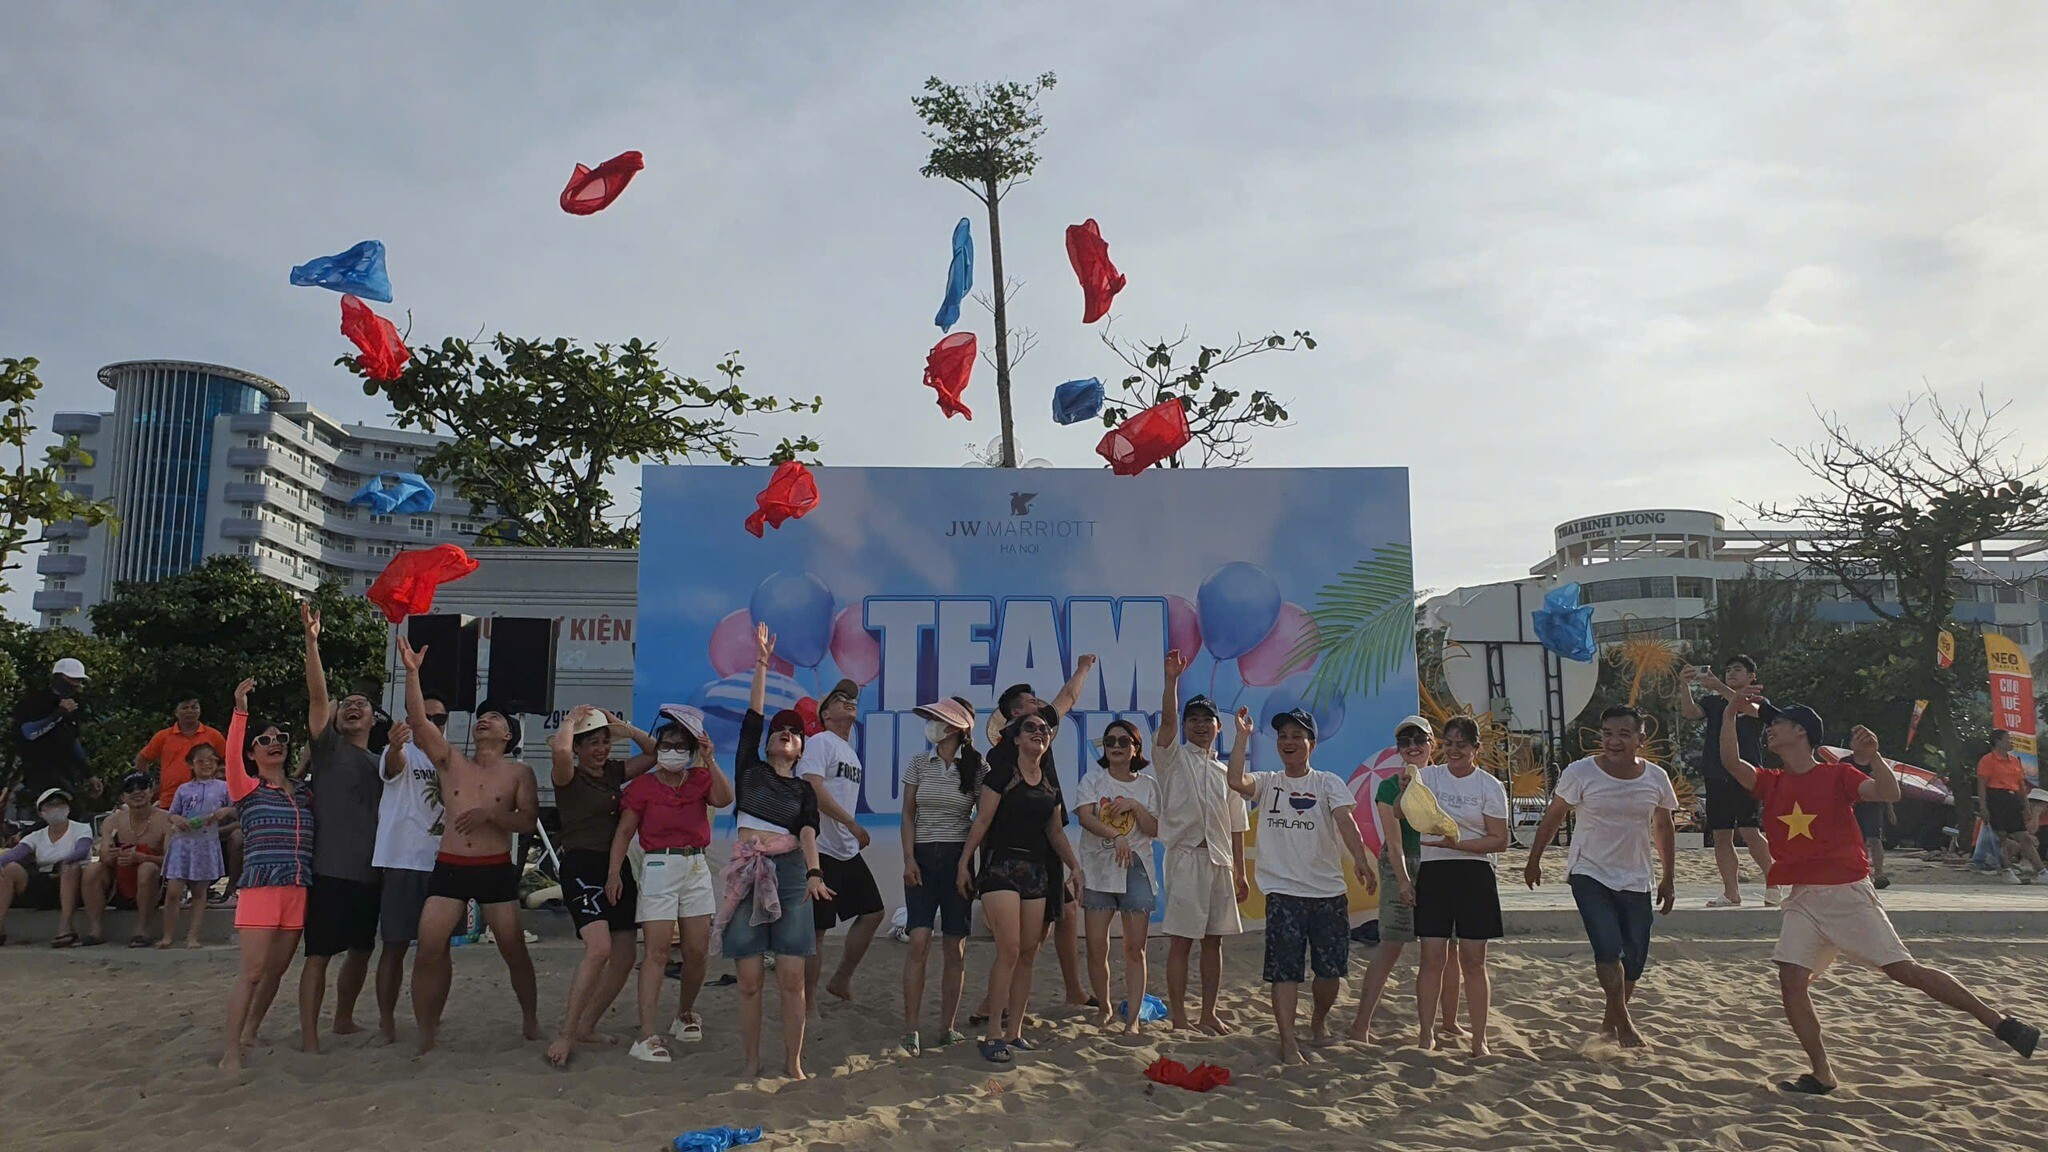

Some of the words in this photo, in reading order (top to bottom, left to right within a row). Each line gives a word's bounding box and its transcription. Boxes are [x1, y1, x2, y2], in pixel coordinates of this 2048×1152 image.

[945, 520, 981, 537] JW
[986, 520, 1098, 538] MARRIOTT
[1558, 523, 1580, 540] THAI
[1580, 516, 1612, 533] BINH
[1616, 512, 1665, 527] DUONG
[1582, 529, 1606, 540] HOTEL
[570, 614, 632, 645] KIỆN
[864, 596, 1169, 711] TEAM
[1269, 787, 1284, 813] I
[1267, 818, 1315, 830] THAILAND
